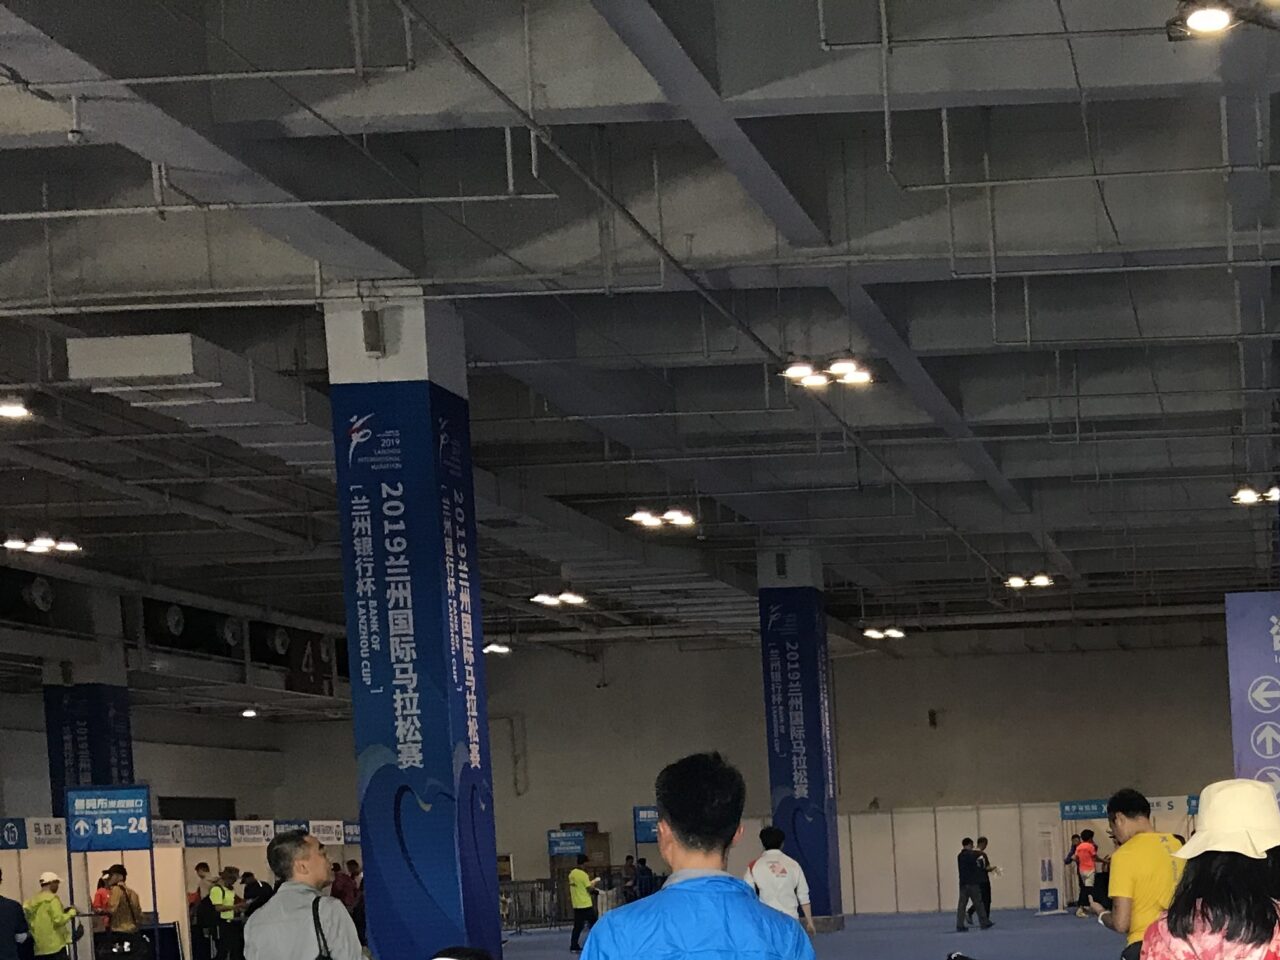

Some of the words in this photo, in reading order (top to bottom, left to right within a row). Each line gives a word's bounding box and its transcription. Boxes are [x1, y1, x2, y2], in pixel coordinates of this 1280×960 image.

[380, 438, 400, 447] 2019
[357, 599, 370, 658] LANZHOU
[368, 599, 379, 632] BANK
[380, 481, 424, 769] 2019兰州国际马拉松赛
[370, 635, 380, 652] OF
[360, 659, 372, 686] CUP
[1167, 801, 1174, 810] S
